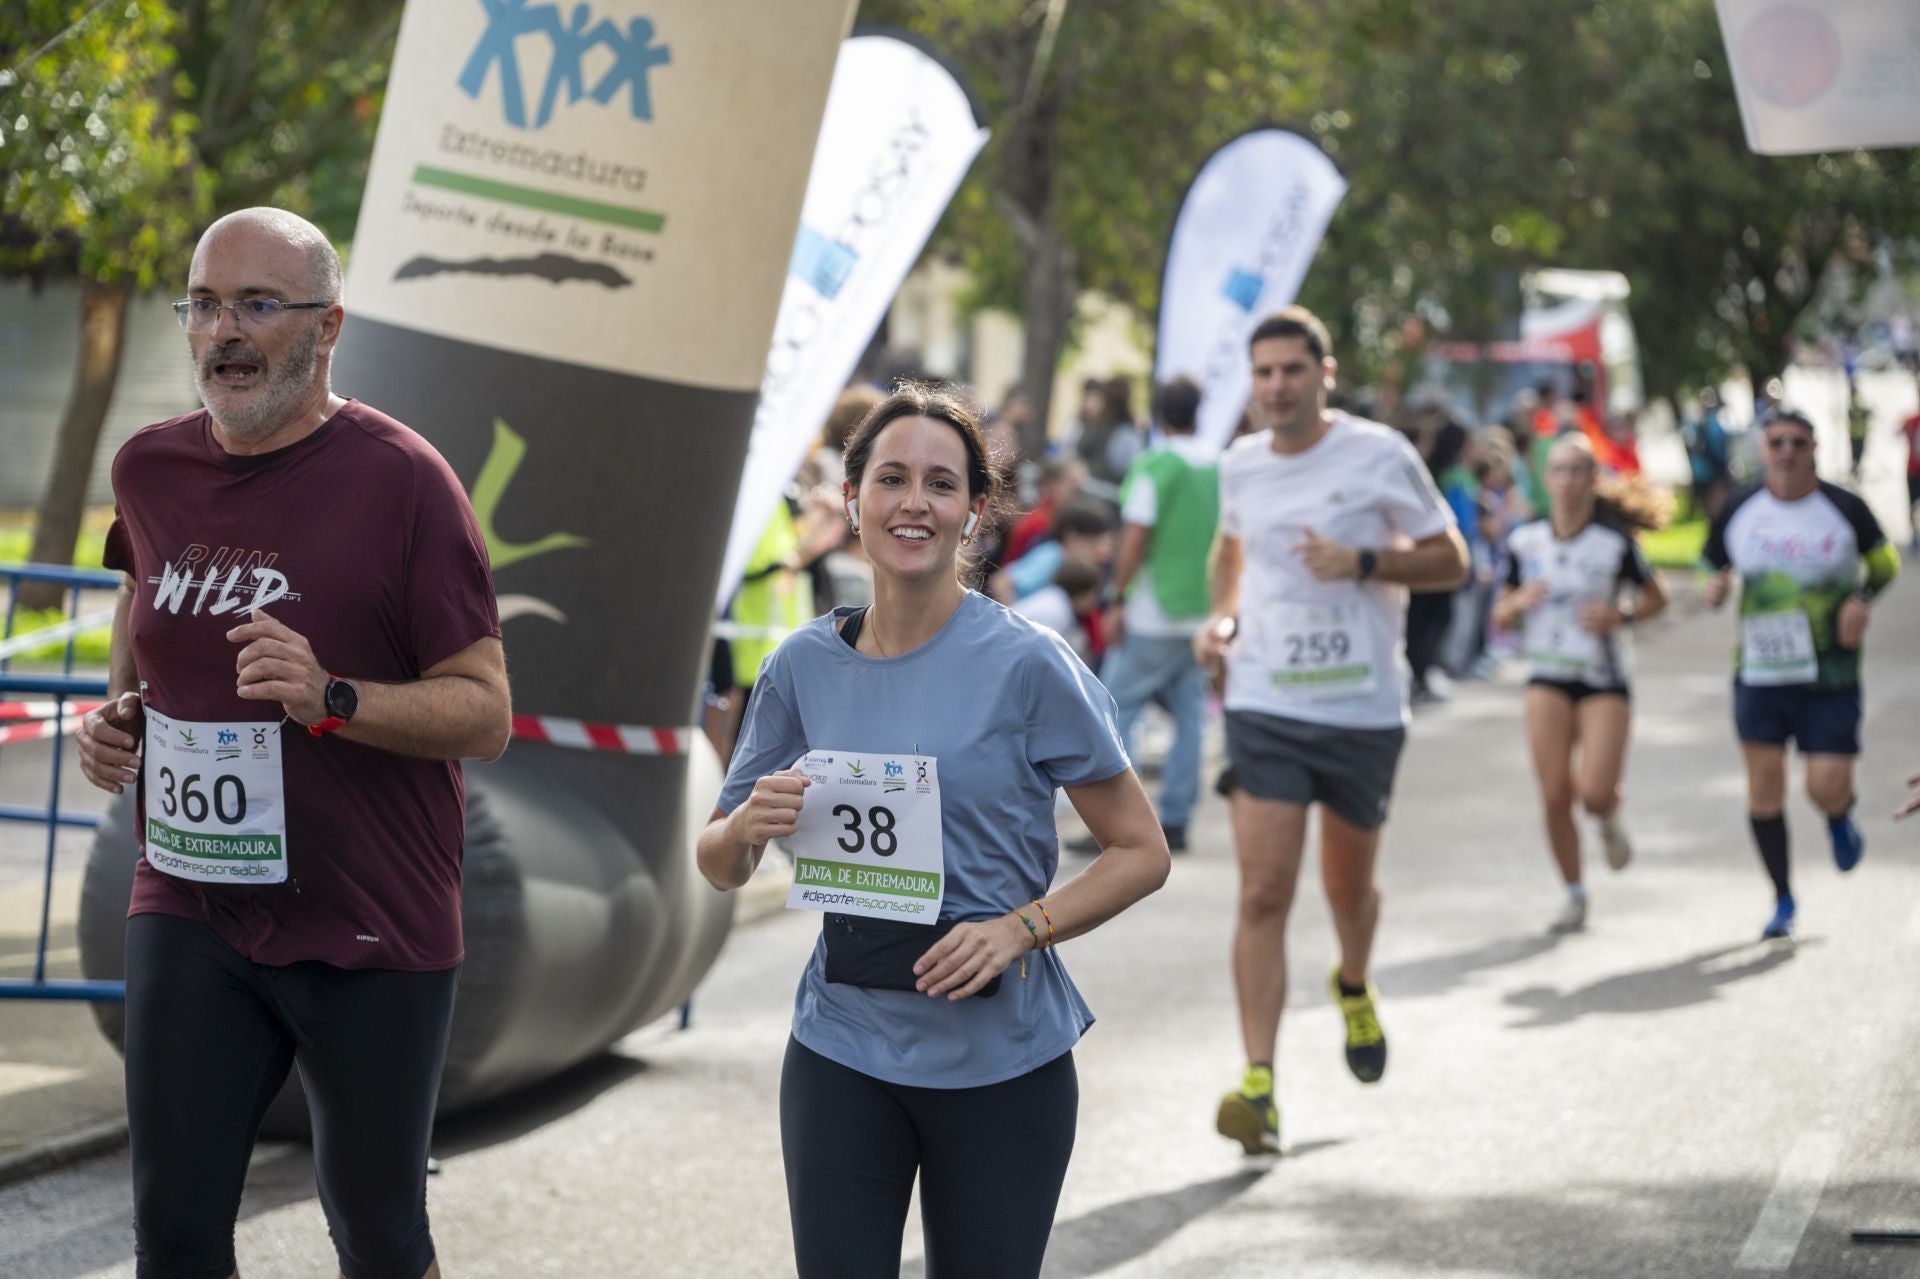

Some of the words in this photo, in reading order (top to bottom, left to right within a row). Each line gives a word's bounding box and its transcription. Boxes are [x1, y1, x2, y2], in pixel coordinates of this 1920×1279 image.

[439, 123, 648, 192] Extremadura
[485, 212, 556, 242] desde
[173, 543, 279, 586] RUN
[153, 561, 289, 618] WILD
[1284, 631, 1350, 664] 259
[160, 766, 247, 825] 360
[840, 777, 877, 786] Extremadura
[171, 833, 181, 849] DE
[185, 837, 277, 855] EXTREMADURA
[832, 803, 897, 857] 38
[153, 851, 270, 876] #deporteresponsable
[800, 863, 832, 882] JUNTA
[838, 868, 851, 883] DE
[856, 870, 936, 894] EXTREMADURA
[802, 889, 925, 914] #deporteresponsable
